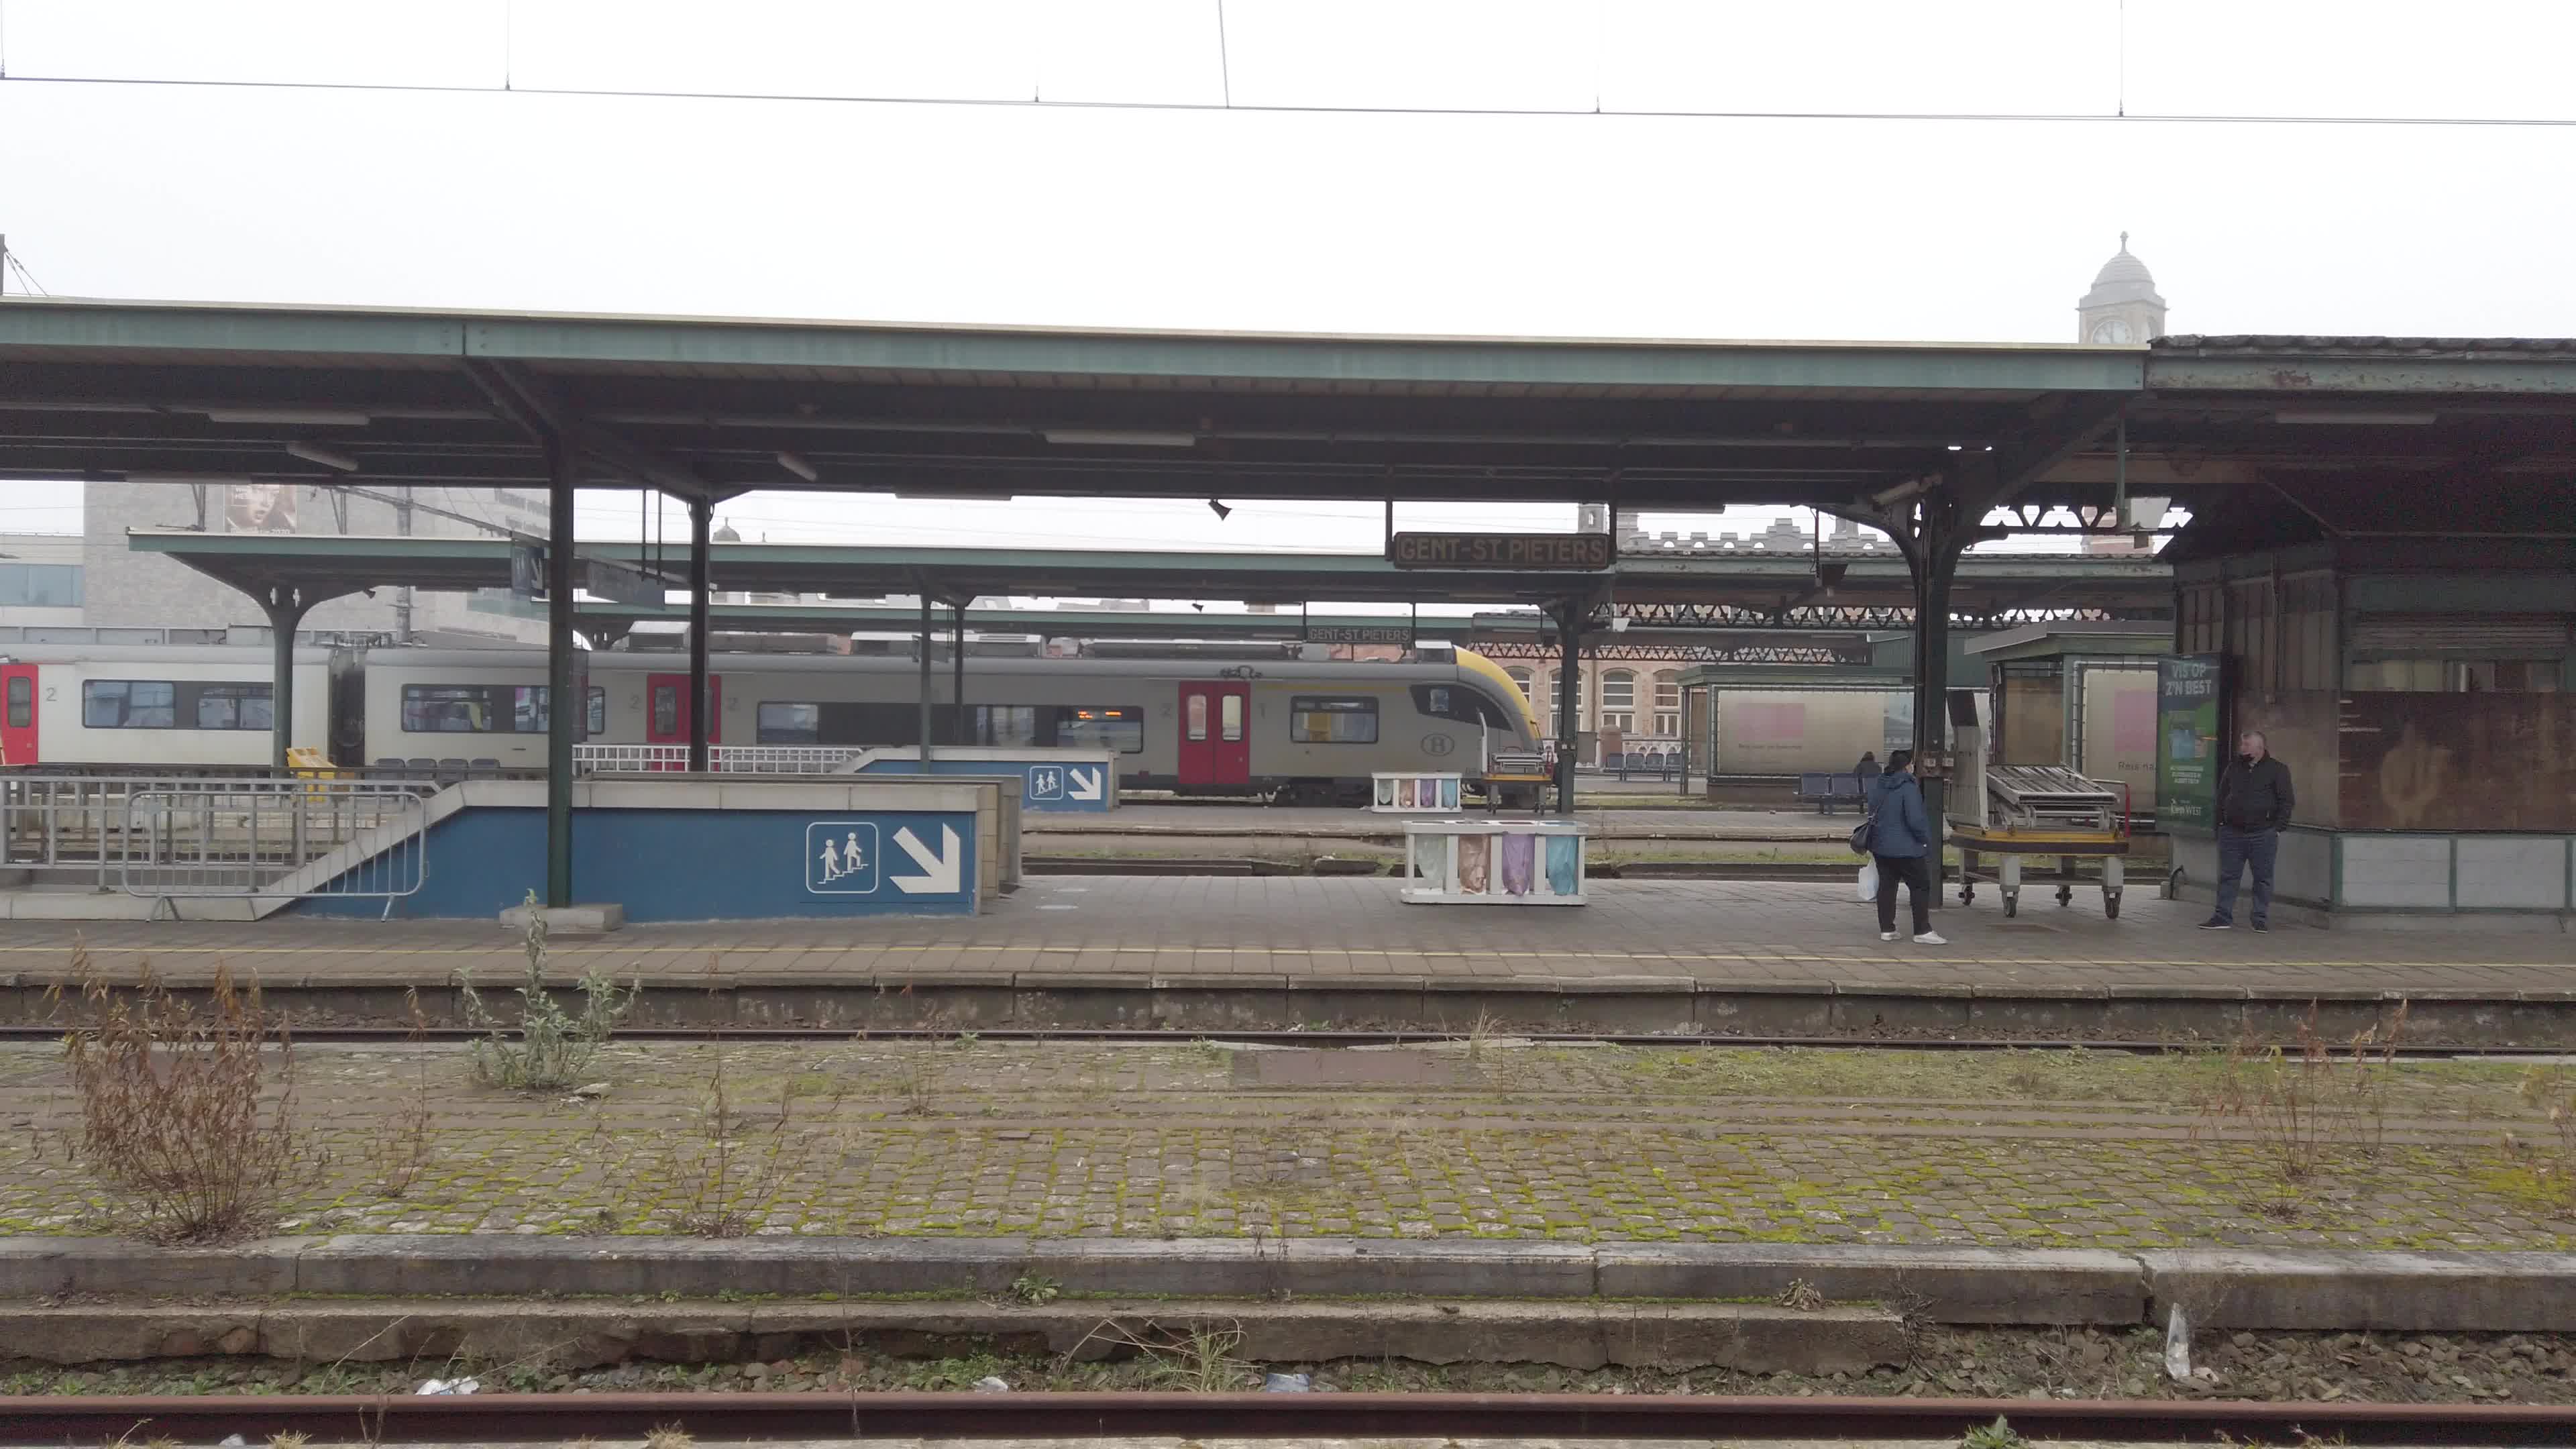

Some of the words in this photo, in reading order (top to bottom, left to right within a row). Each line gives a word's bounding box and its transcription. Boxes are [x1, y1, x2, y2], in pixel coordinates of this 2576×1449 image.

[1509, 539, 1604, 562] PIETERS
[1363, 629, 1409, 641] PIETERS
[2171, 664, 2189, 678] VIS
[2192, 663, 2206, 677] OP
[46, 687, 58, 702] 2
[2185, 679, 2212, 695] BEST
